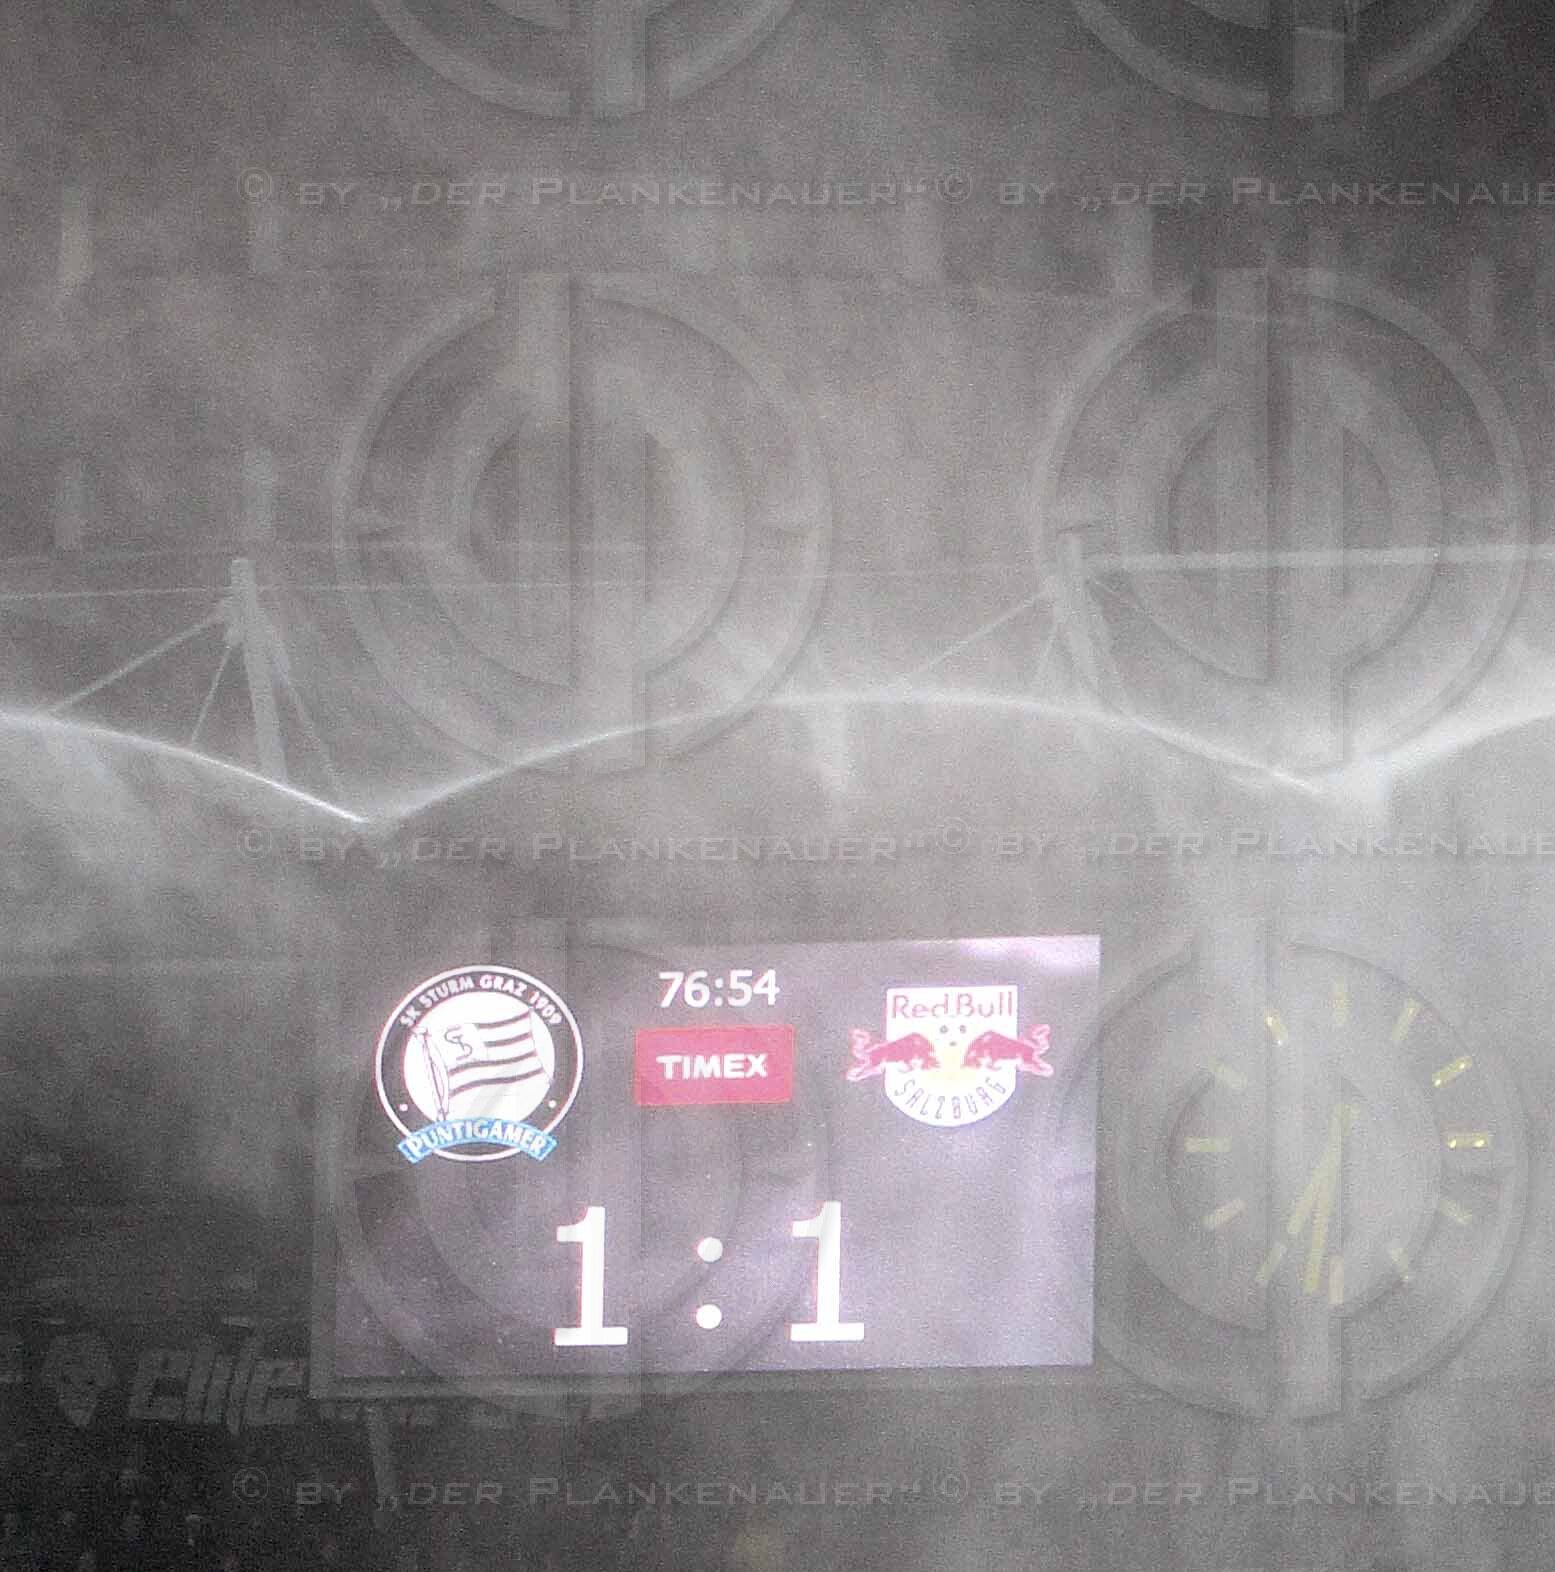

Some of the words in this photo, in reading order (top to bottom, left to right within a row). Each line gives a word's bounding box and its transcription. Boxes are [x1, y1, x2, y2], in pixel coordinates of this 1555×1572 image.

[399, 1006, 422, 1027] SK
[420, 976, 476, 1009] STURM
[478, 974, 528, 997] GRAZ
[529, 990, 564, 1025] 1909
[658, 968, 781, 1009] 76:54
[656, 1053, 768, 1081] TIMEX
[896, 1075, 1007, 1121] SALZBURG
[405, 1122, 548, 1156] PUNTIGAMER
[554, 1206, 629, 1346] 1
[789, 1200, 865, 1342] 1
